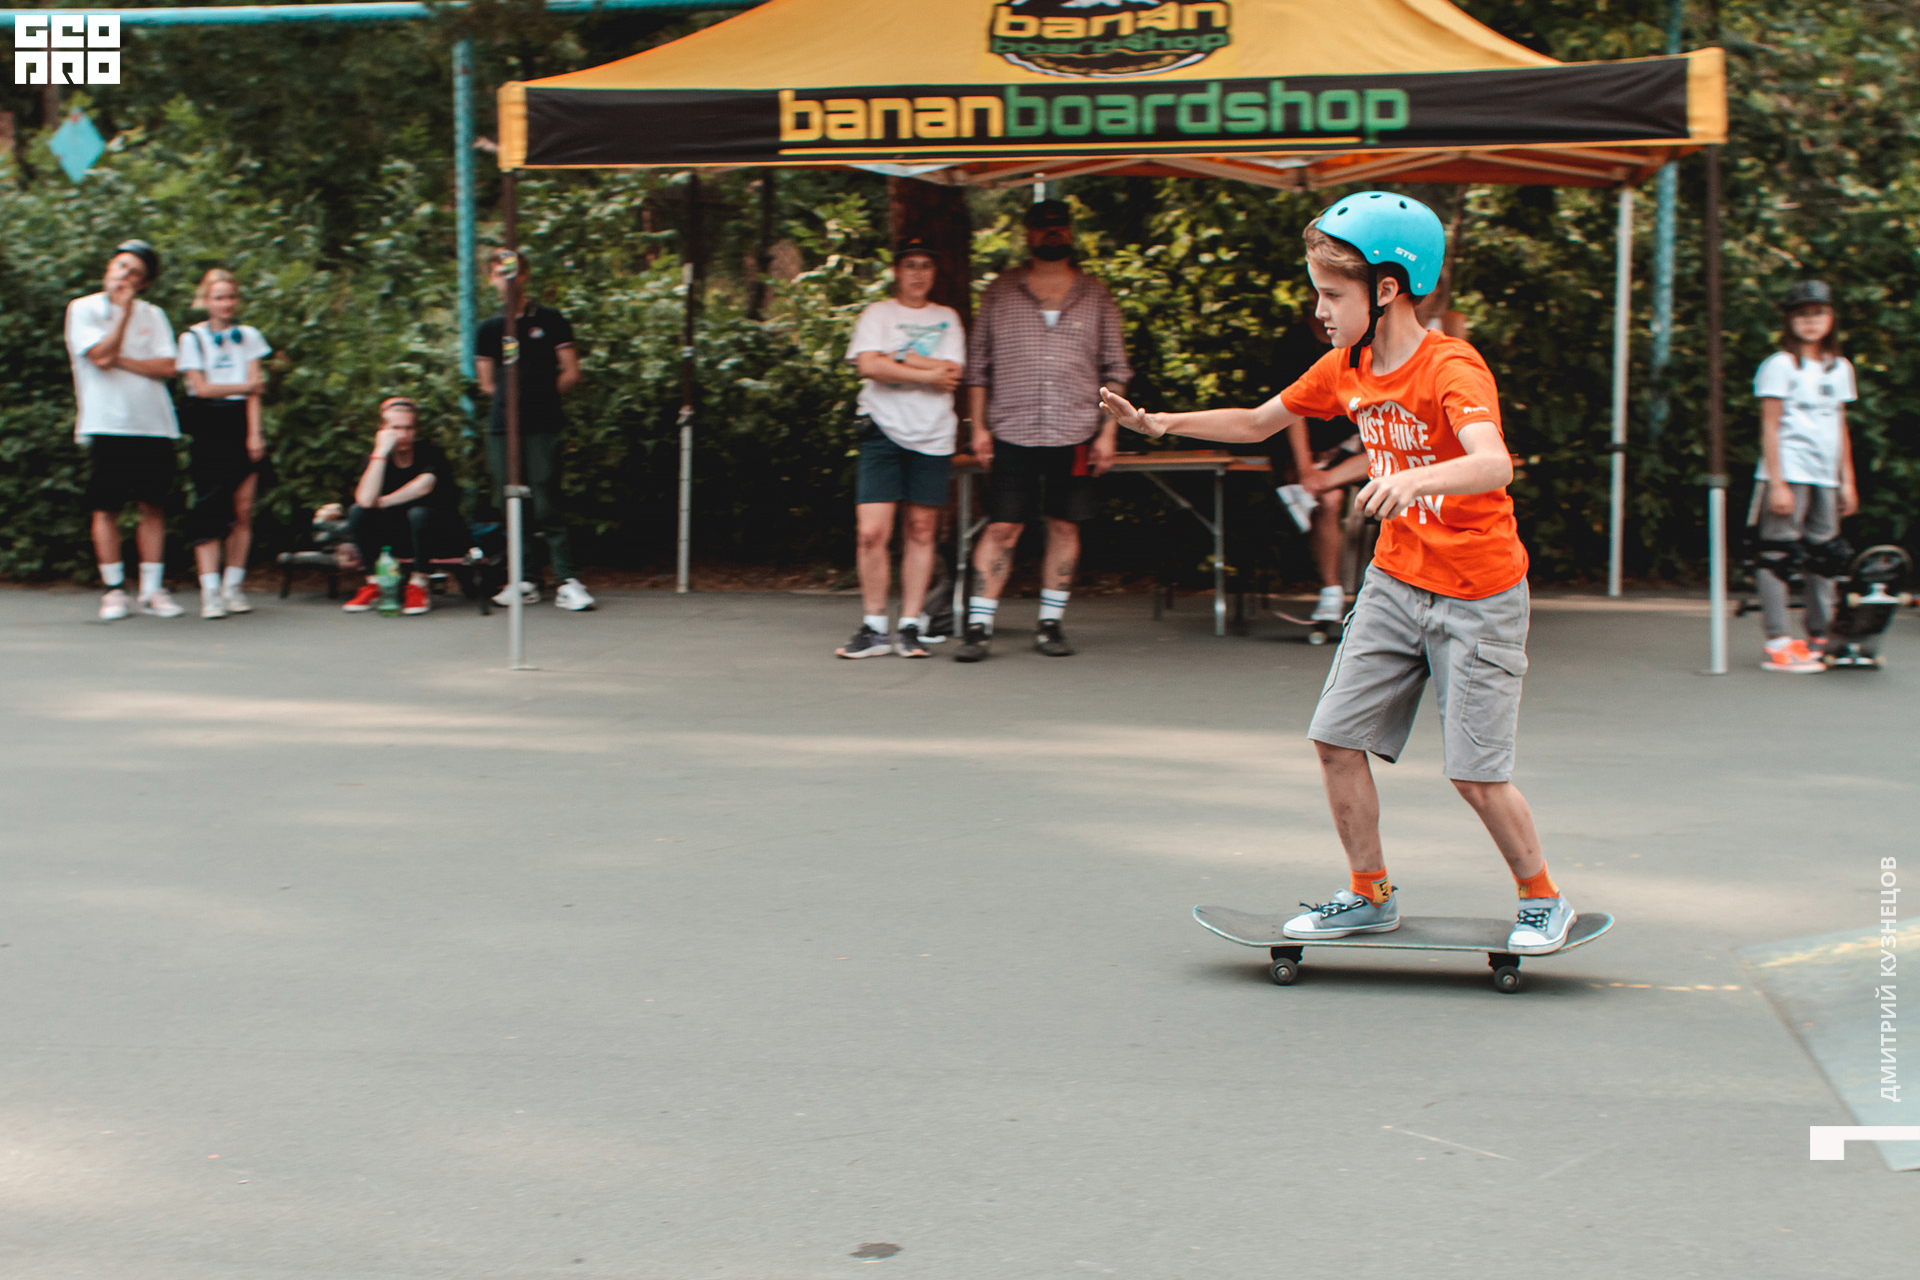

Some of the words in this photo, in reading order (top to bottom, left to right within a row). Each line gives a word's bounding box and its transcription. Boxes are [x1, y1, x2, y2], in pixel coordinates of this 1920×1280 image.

[993, 1, 1229, 39] banan
[1394, 246, 1418, 262] STG
[1356, 412, 1386, 446] UST
[1388, 421, 1432, 451] HIKE
